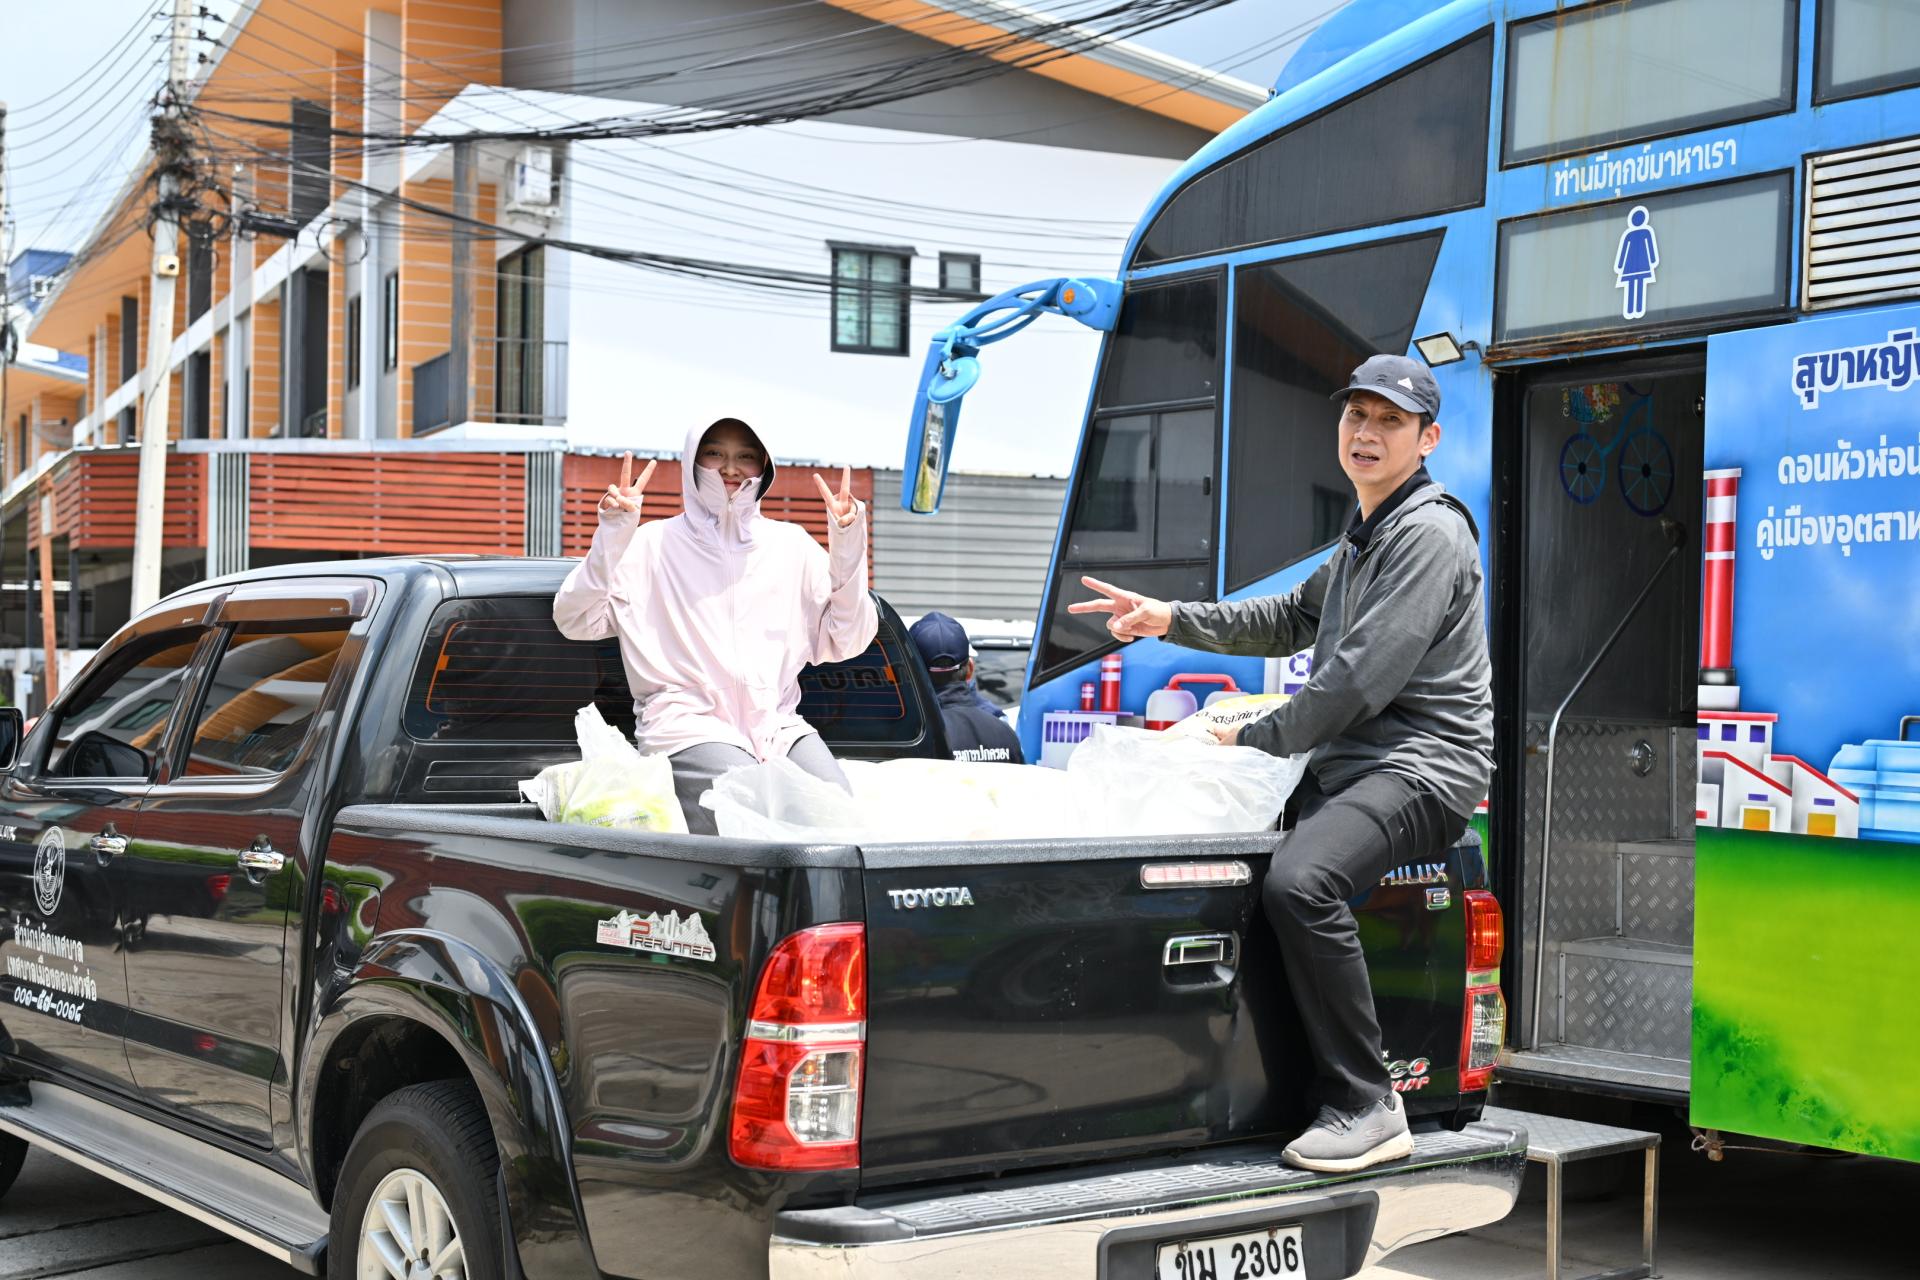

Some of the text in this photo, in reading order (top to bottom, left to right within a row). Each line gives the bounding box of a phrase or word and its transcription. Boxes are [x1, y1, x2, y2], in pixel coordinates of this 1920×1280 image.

[1554, 138, 1737, 198] ท่านมีทุกข์มาหาเรา
[1778, 434, 1920, 484] ดอนหัวฬ่อน
[887, 886, 974, 910] TOYOTA
[629, 920, 712, 958] PRERUNNER
[1383, 1057, 1431, 1079] GO
[1391, 1076, 1430, 1092] AMP
[1231, 1235, 1299, 1280] 2306
